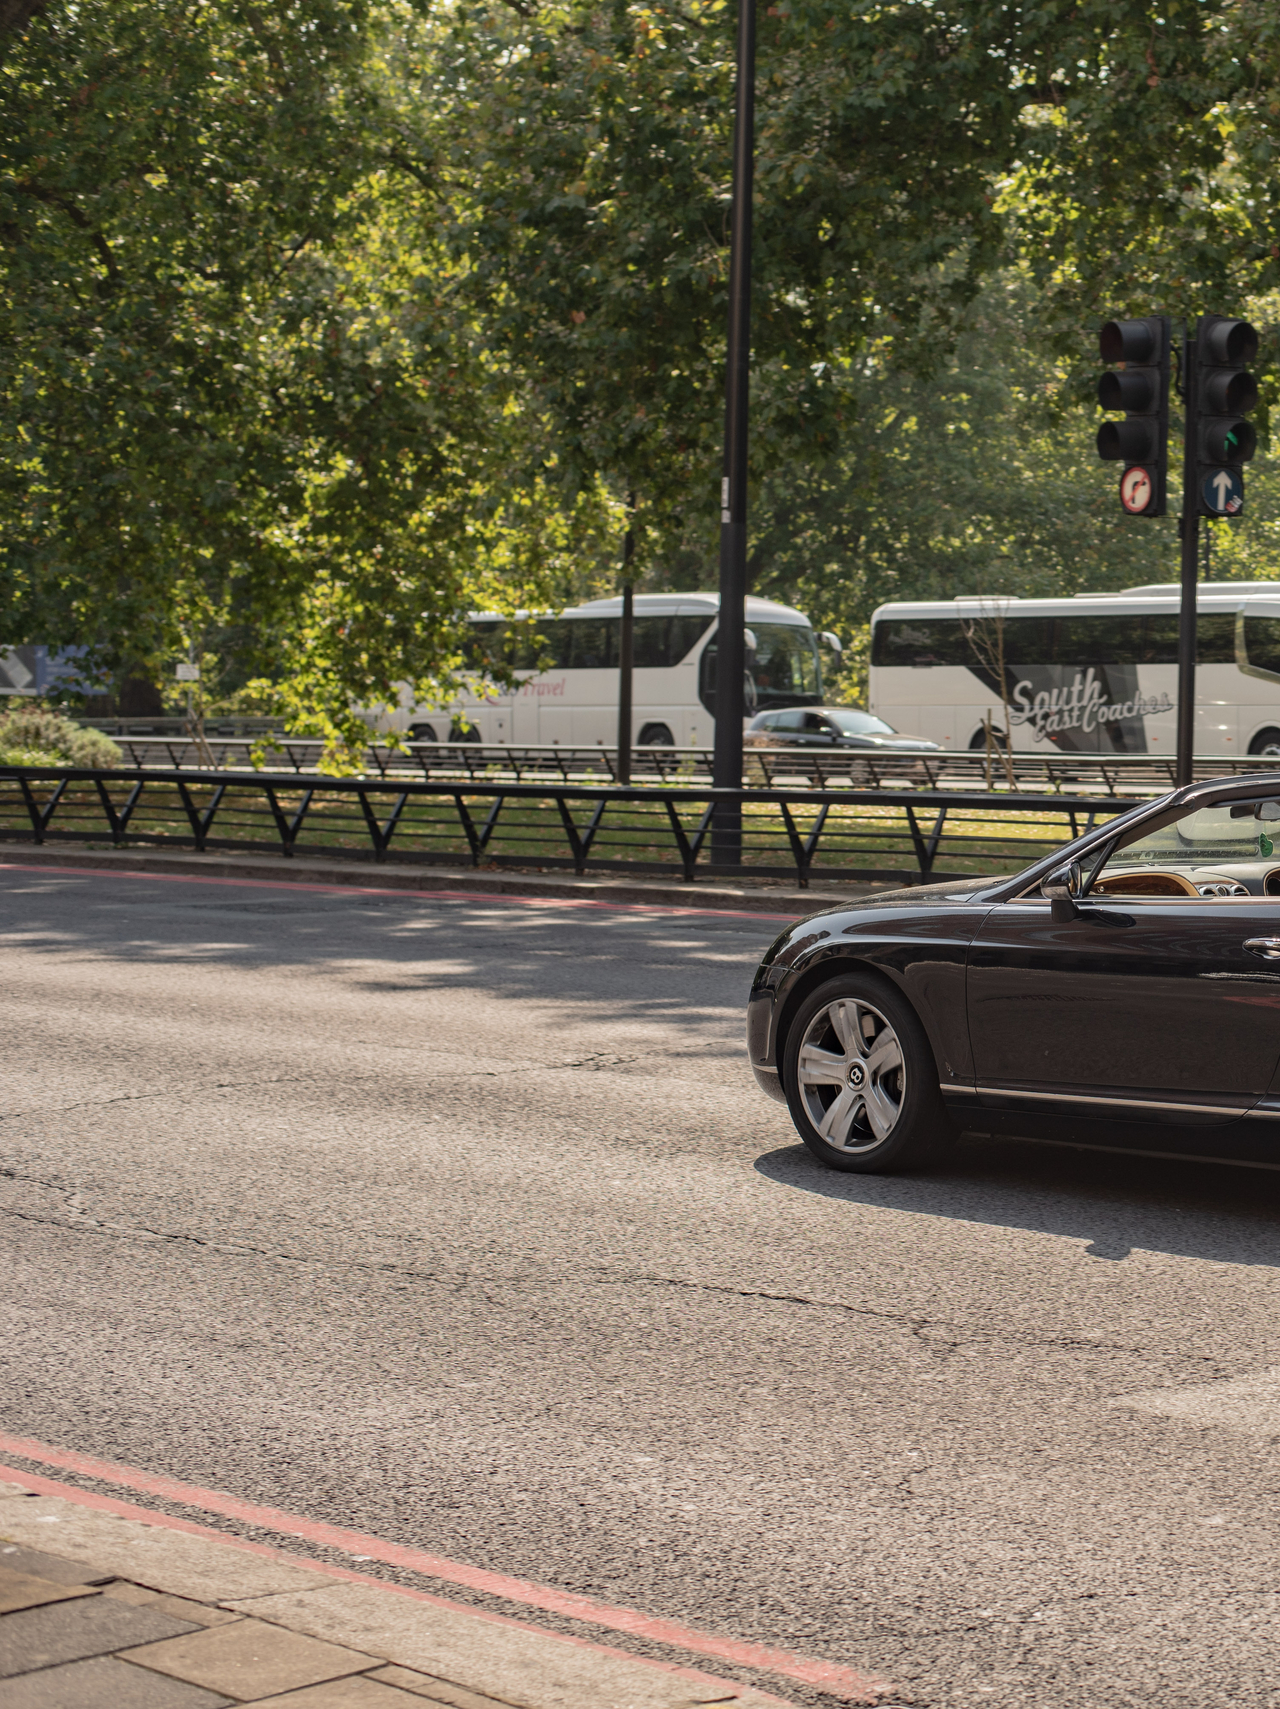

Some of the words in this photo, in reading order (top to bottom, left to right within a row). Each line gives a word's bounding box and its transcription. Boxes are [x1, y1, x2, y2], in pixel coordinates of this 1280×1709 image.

[522, 677, 566, 697] Travel
[1009, 667, 1108, 725] South
[1033, 707, 1082, 742] East
[1082, 689, 1174, 733] Coaches
